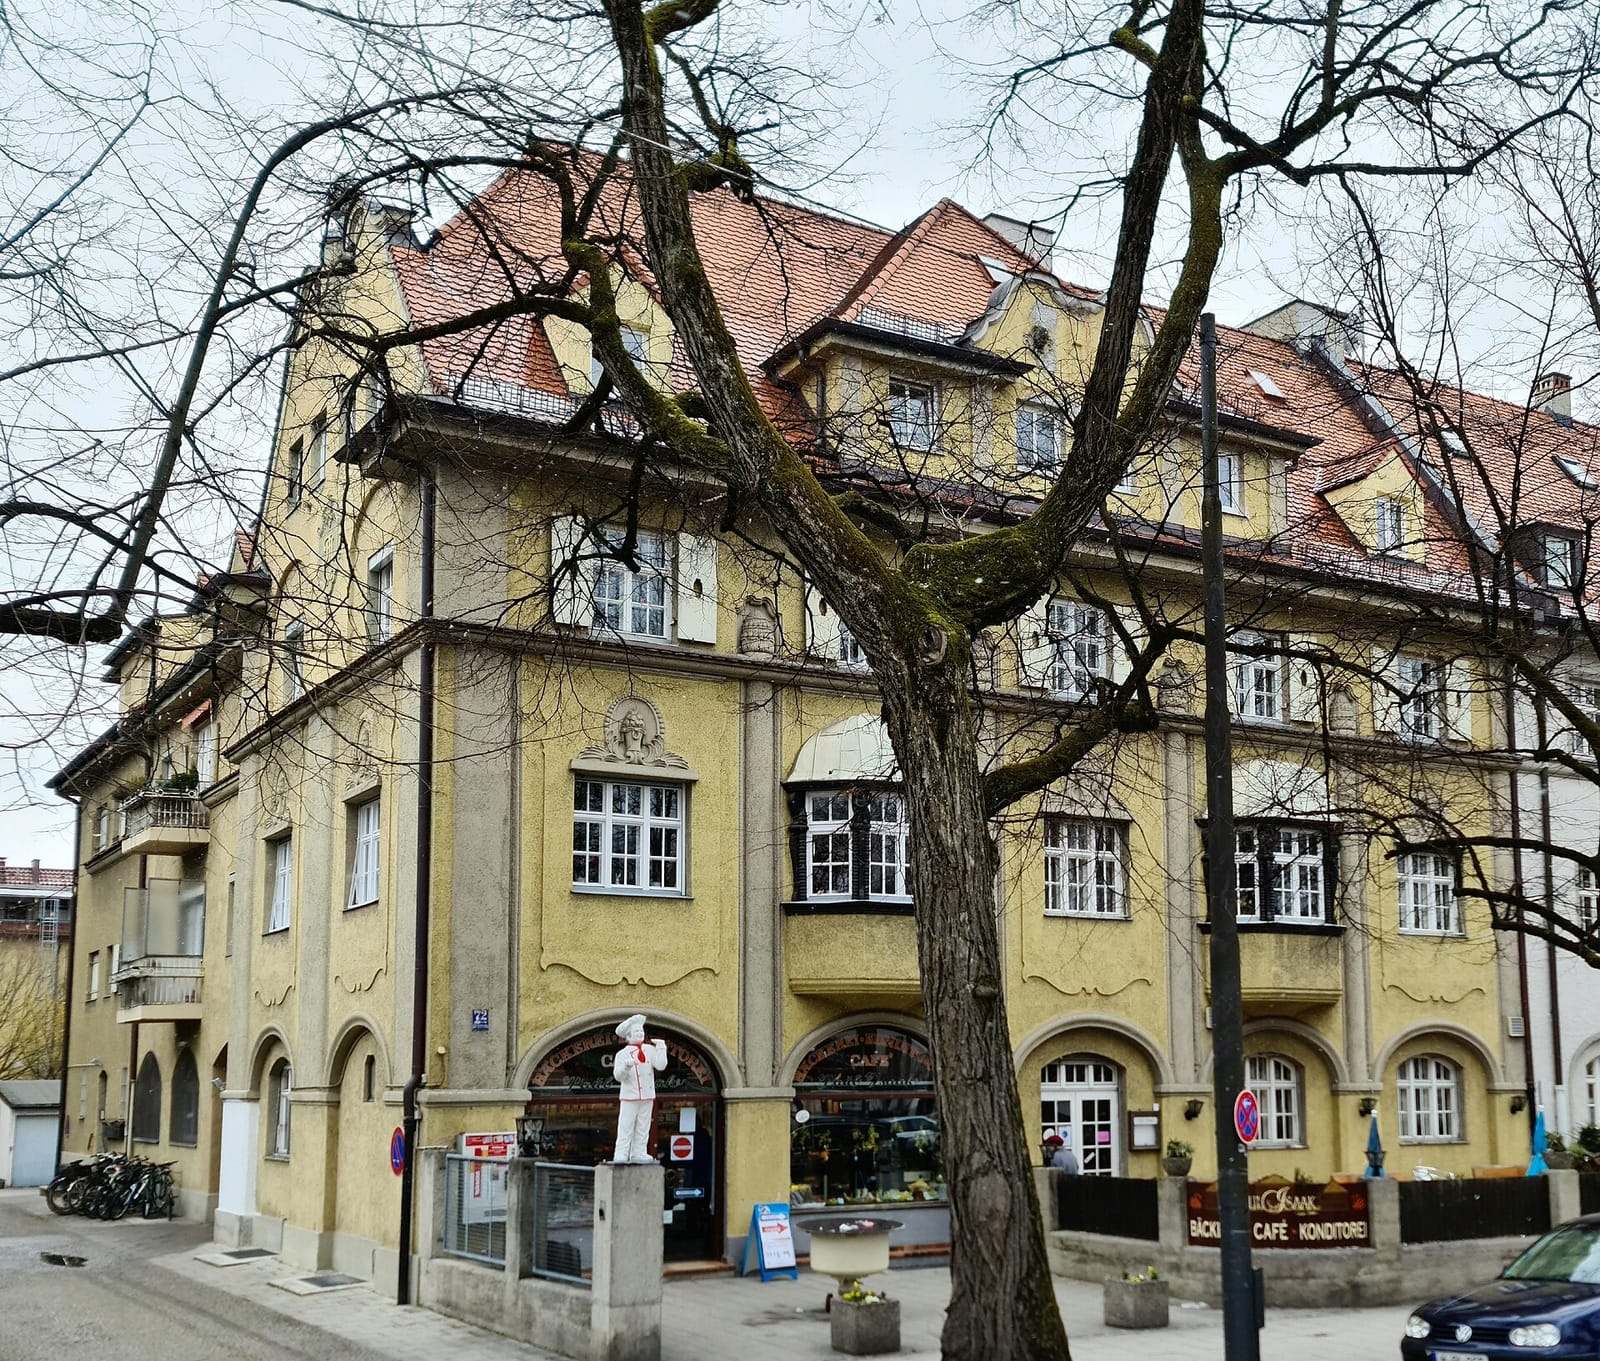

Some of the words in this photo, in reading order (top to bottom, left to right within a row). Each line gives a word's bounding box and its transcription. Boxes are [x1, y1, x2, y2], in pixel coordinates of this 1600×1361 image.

[473, 1010, 488, 1024] 72
[1253, 1219, 1289, 1240] CAFÉ
[1299, 1221, 1368, 1241] KONDITOREI
